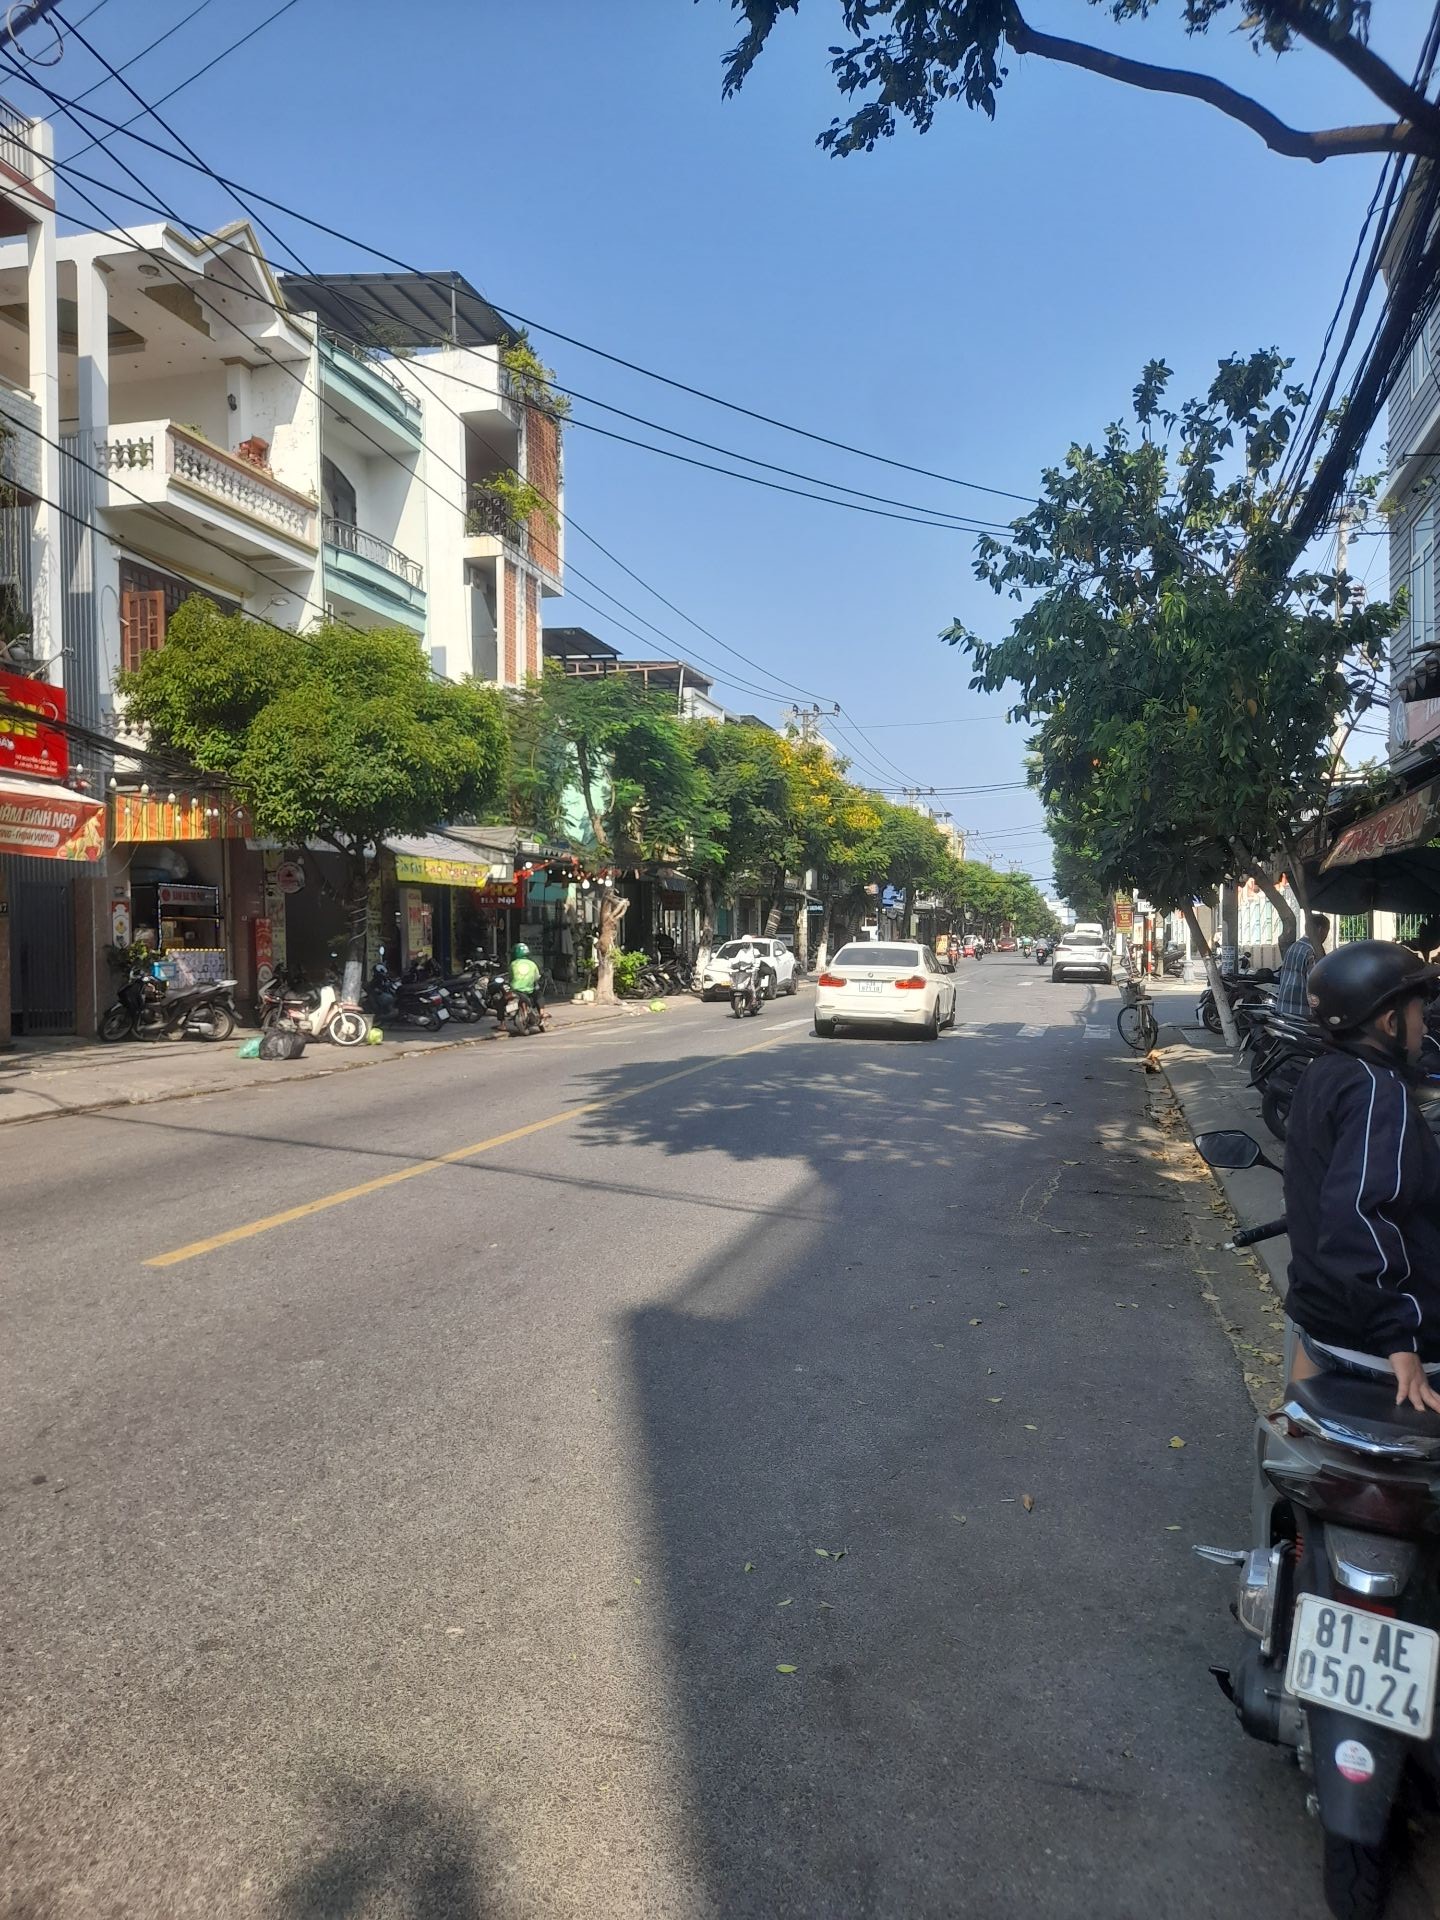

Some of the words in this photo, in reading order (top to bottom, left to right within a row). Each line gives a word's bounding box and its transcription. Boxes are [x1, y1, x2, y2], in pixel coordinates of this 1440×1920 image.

[52, 811, 77, 832] NGỌ
[1316, 1607, 1415, 1674] 81-AE
[1296, 1648, 1420, 1726] 050.24
